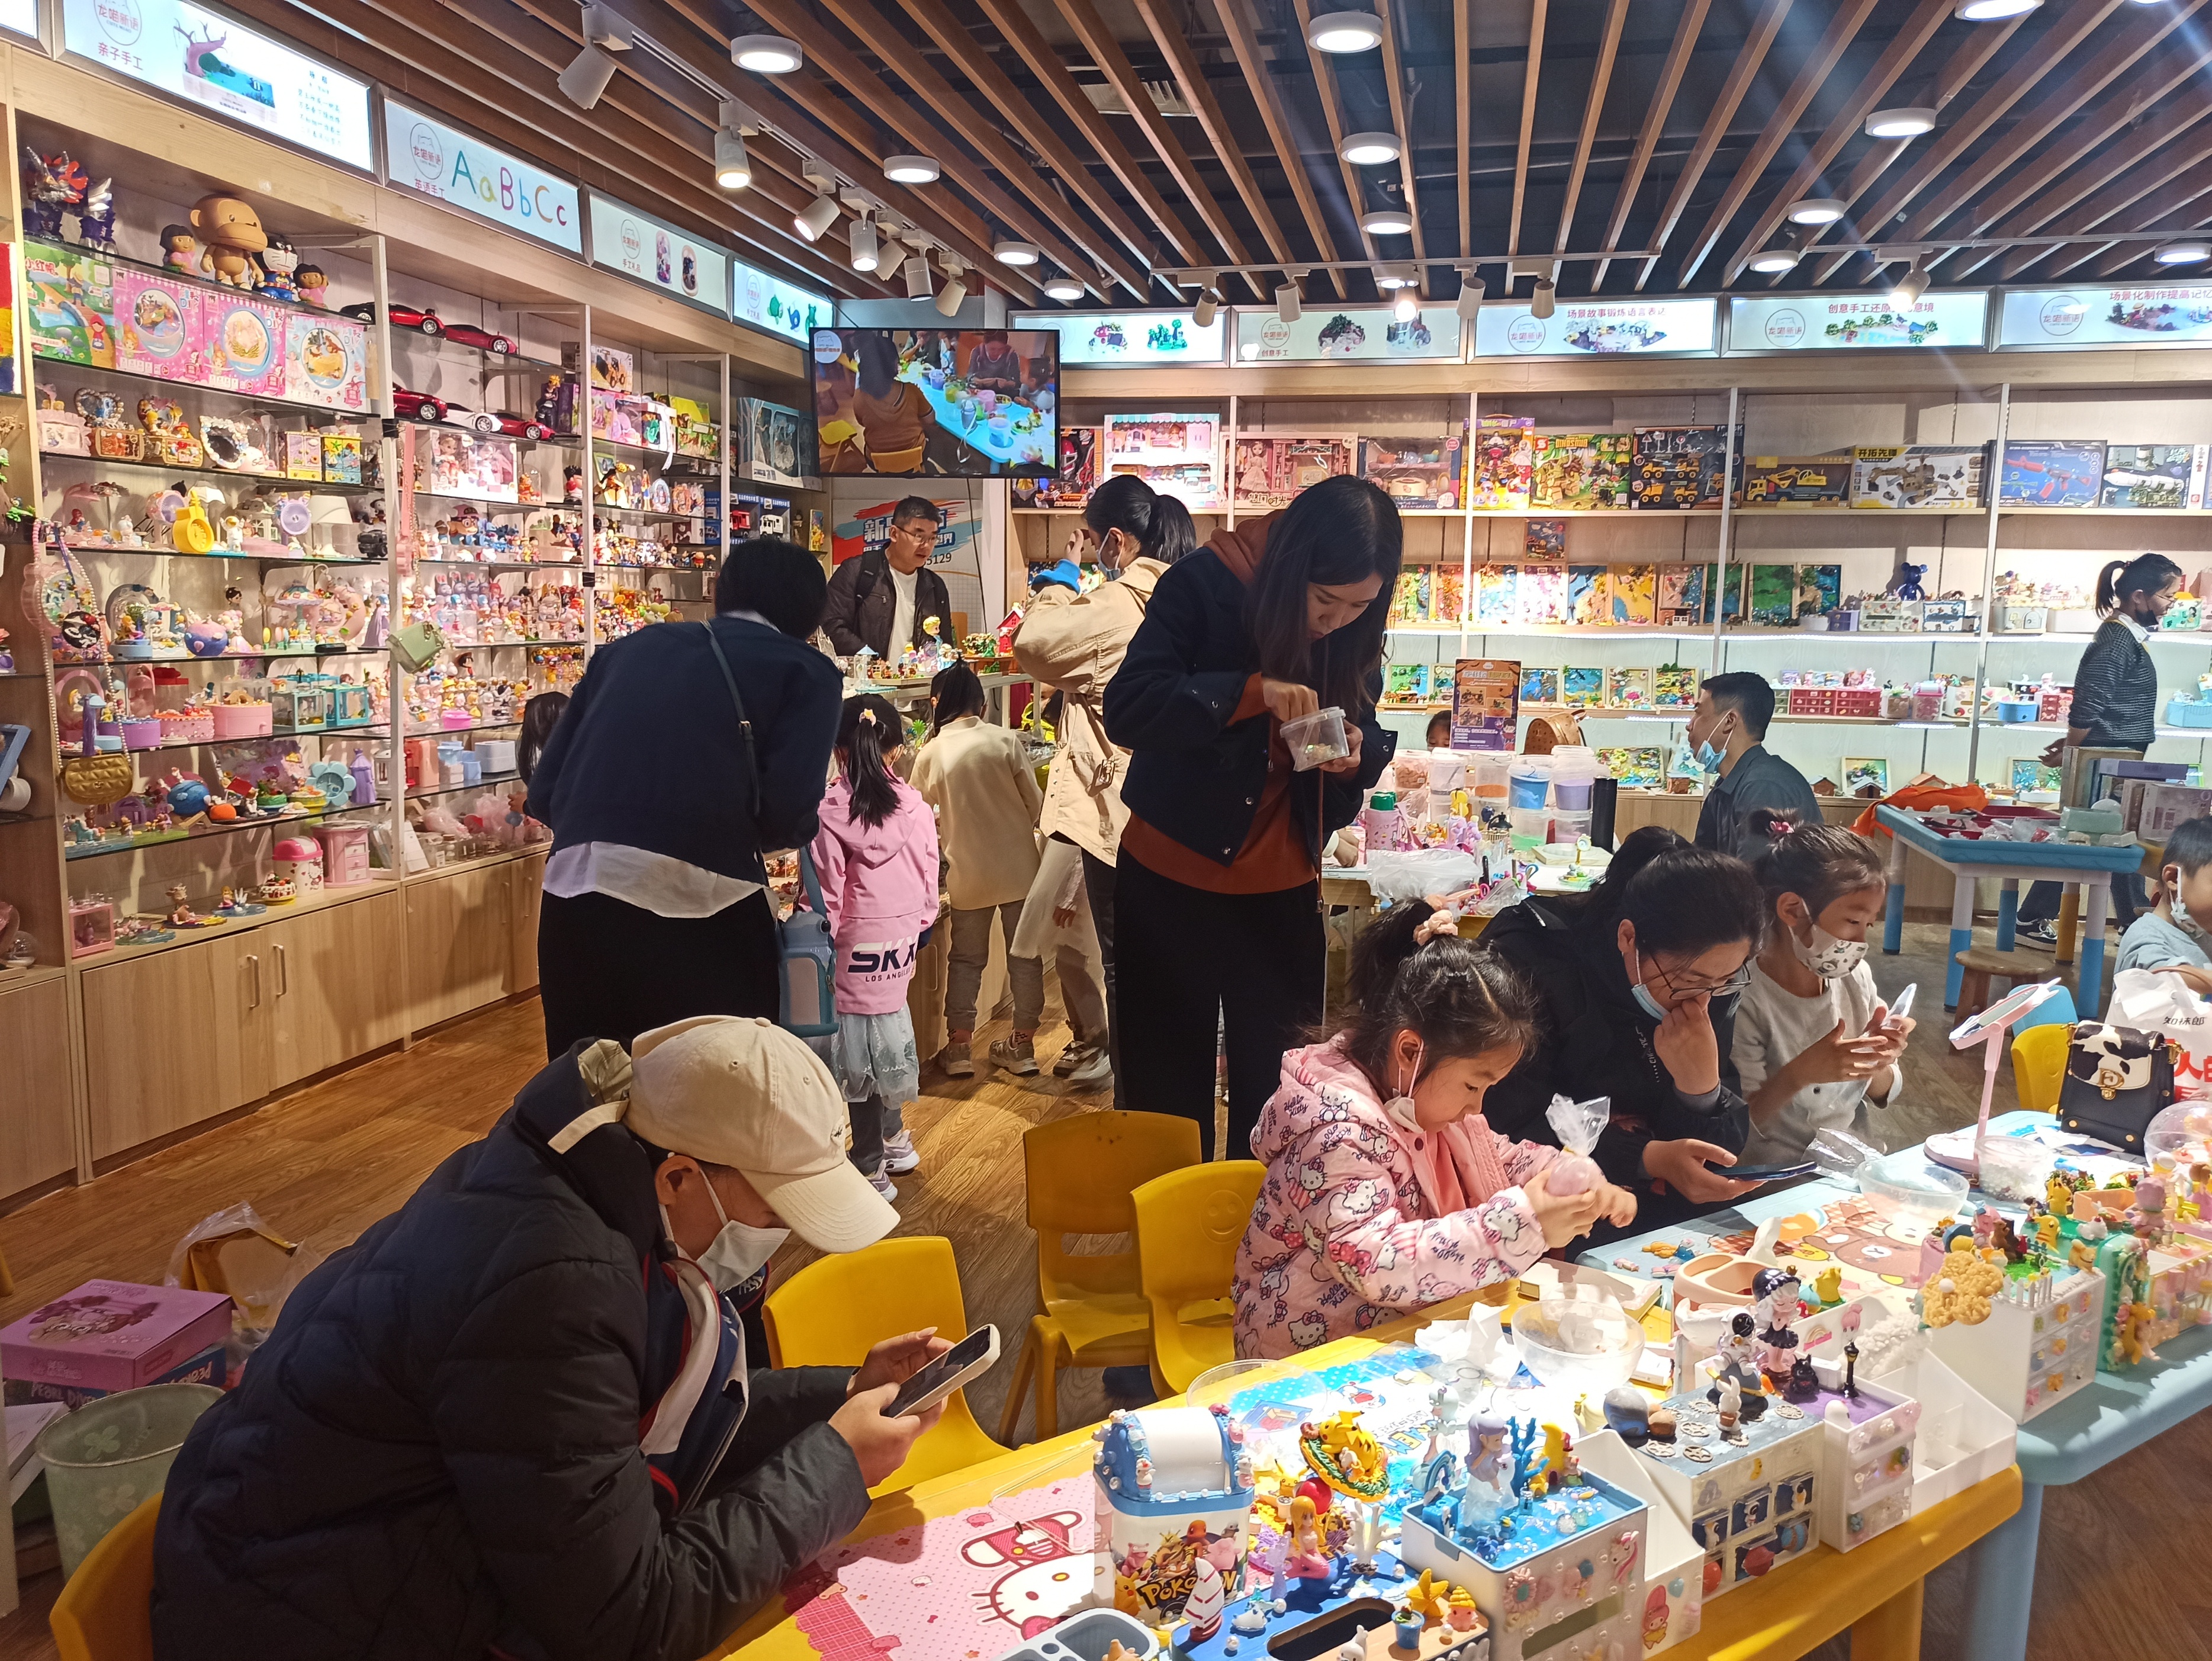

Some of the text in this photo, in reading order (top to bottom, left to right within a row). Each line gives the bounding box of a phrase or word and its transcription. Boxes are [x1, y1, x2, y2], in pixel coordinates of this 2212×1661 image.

[98, 42, 143, 70] 亲子手工
[414, 178, 445, 200] 英语手工
[2110, 289, 2212, 301] 场景化制作提高记忆
[1567, 307, 1667, 319] 场景故事锻炼语言表达
[1828, 303, 1934, 314] 创意手工还原意境
[1858, 448, 1898, 457] 开拓先锋
[1284, 1094, 1305, 1112] Hello
[1289, 1104, 1309, 1119] Kitty
[1316, 1283, 1344, 1307] Hello
